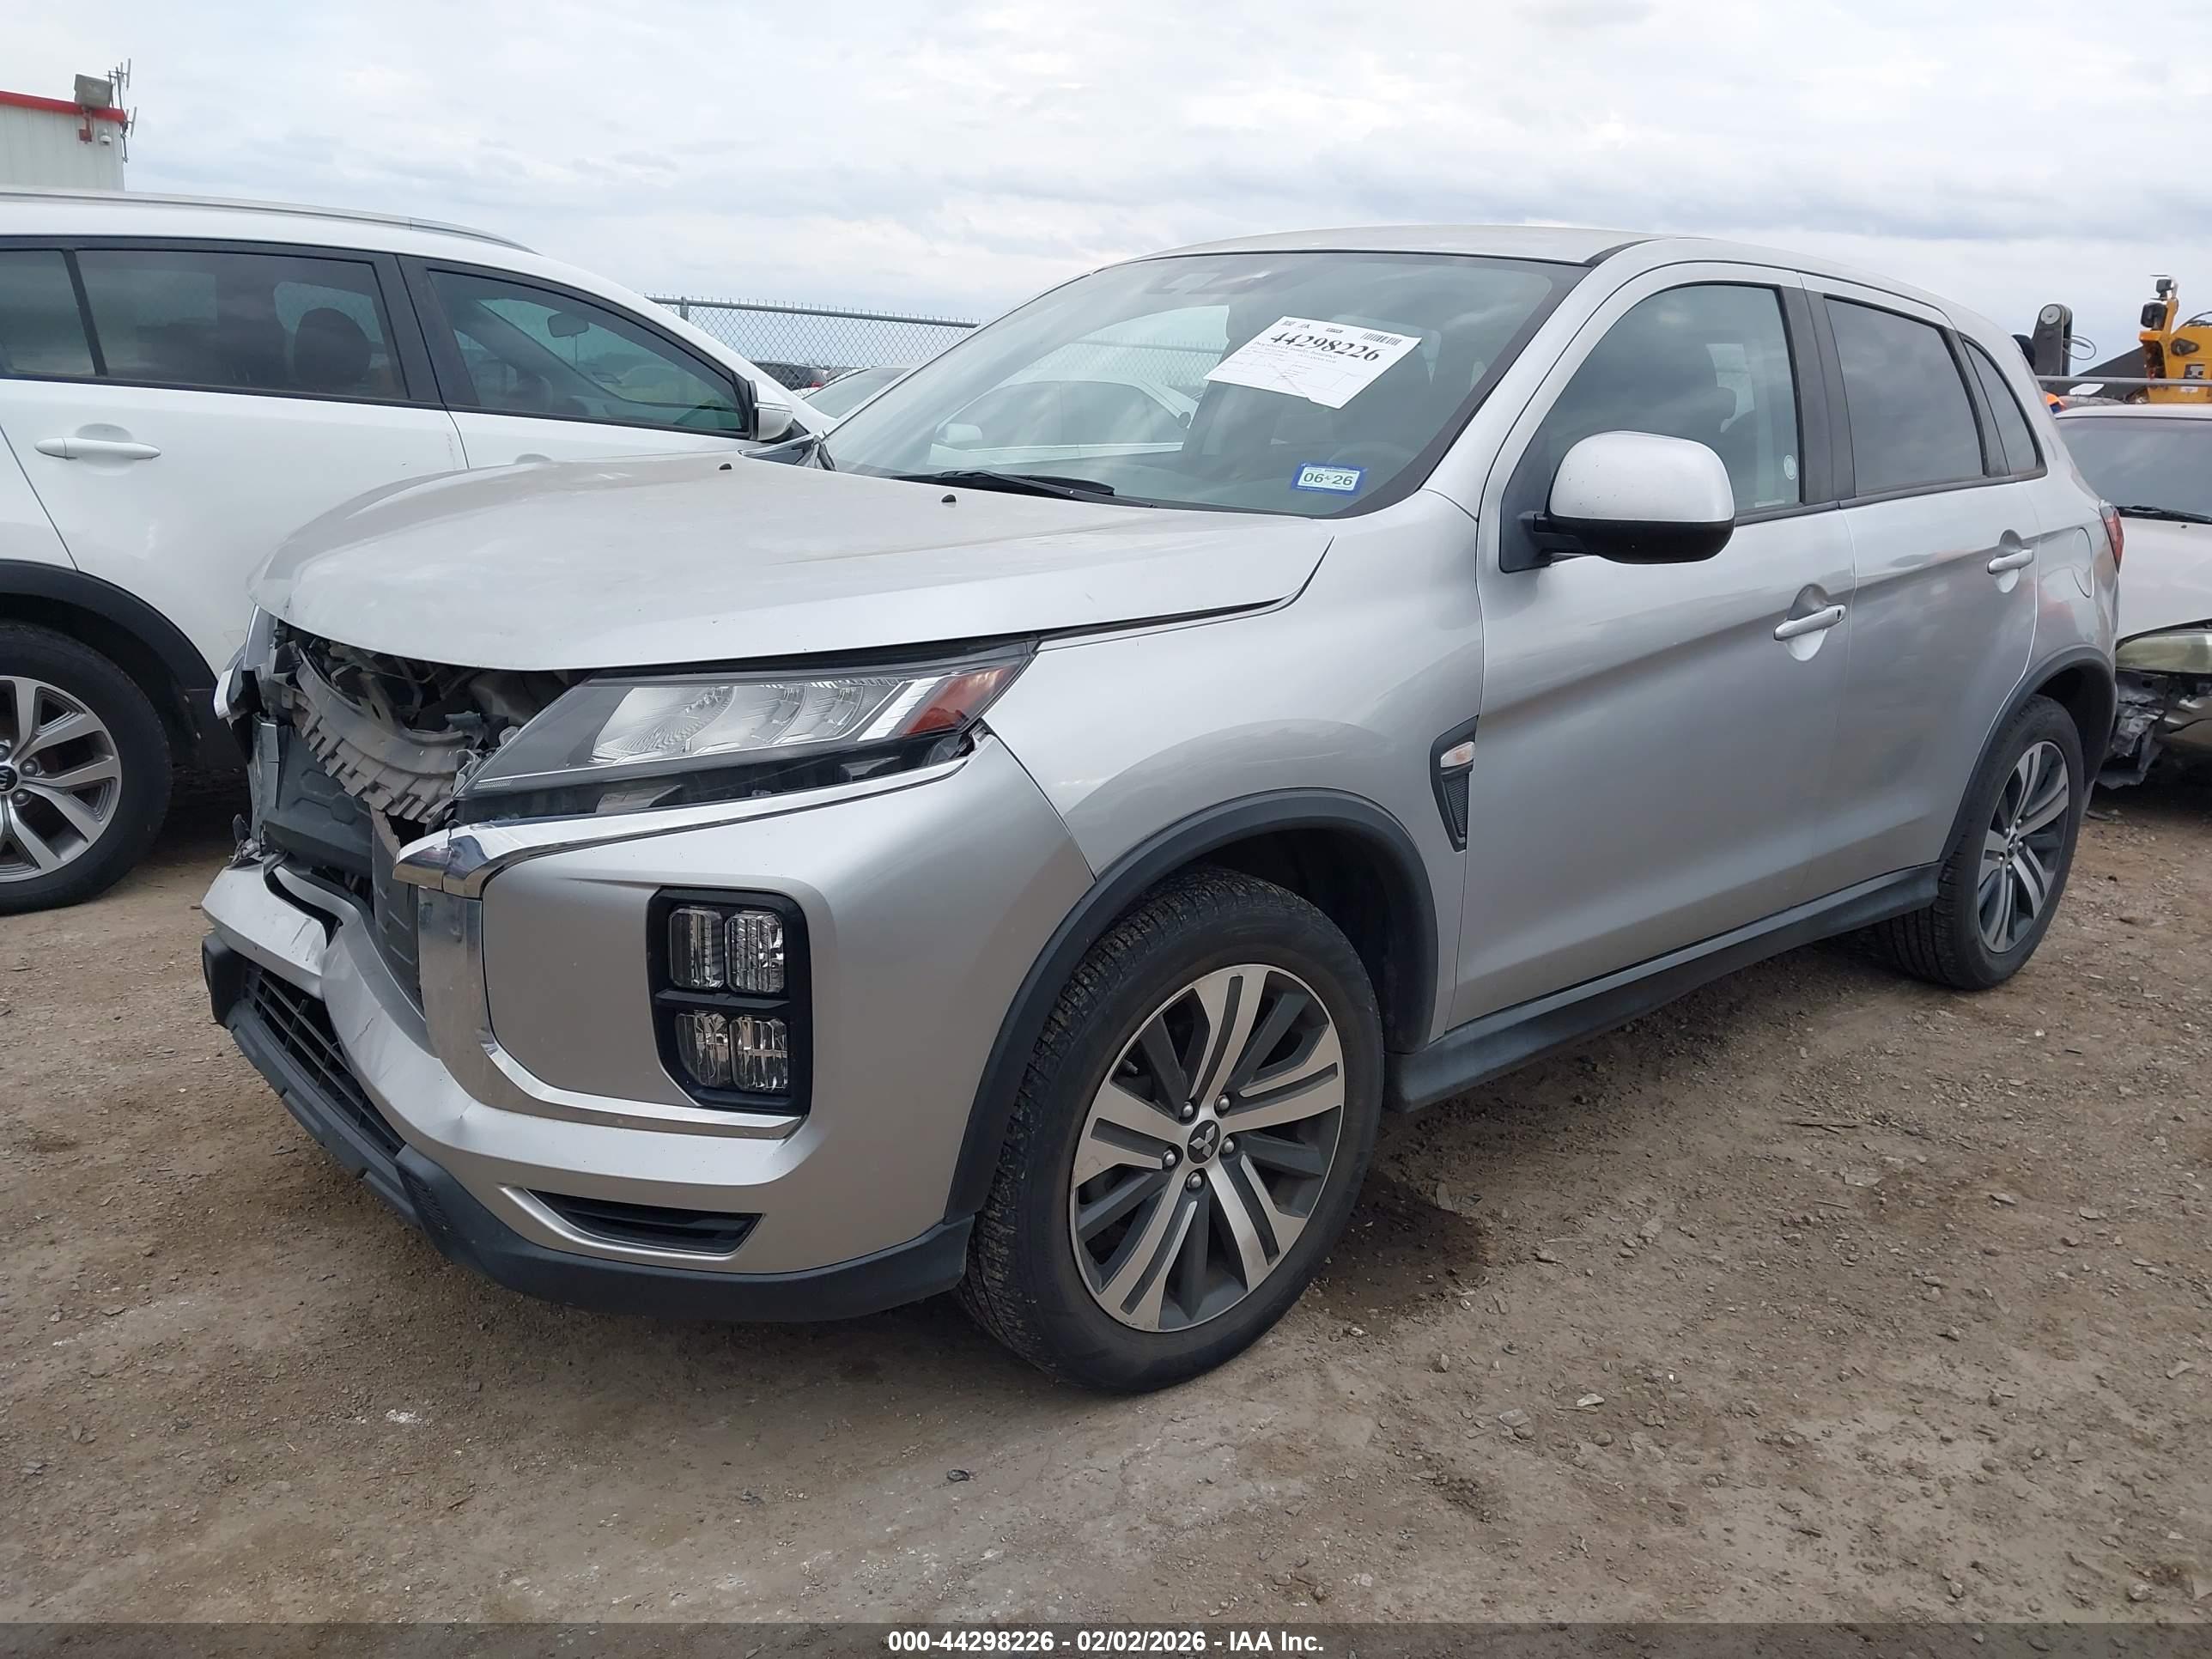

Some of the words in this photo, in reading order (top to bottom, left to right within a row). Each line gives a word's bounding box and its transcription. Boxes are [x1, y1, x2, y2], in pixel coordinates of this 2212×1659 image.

[1270, 331, 1386, 362] 44298226
[1304, 472, 1324, 483] 06
[1332, 475, 1353, 486] 26
